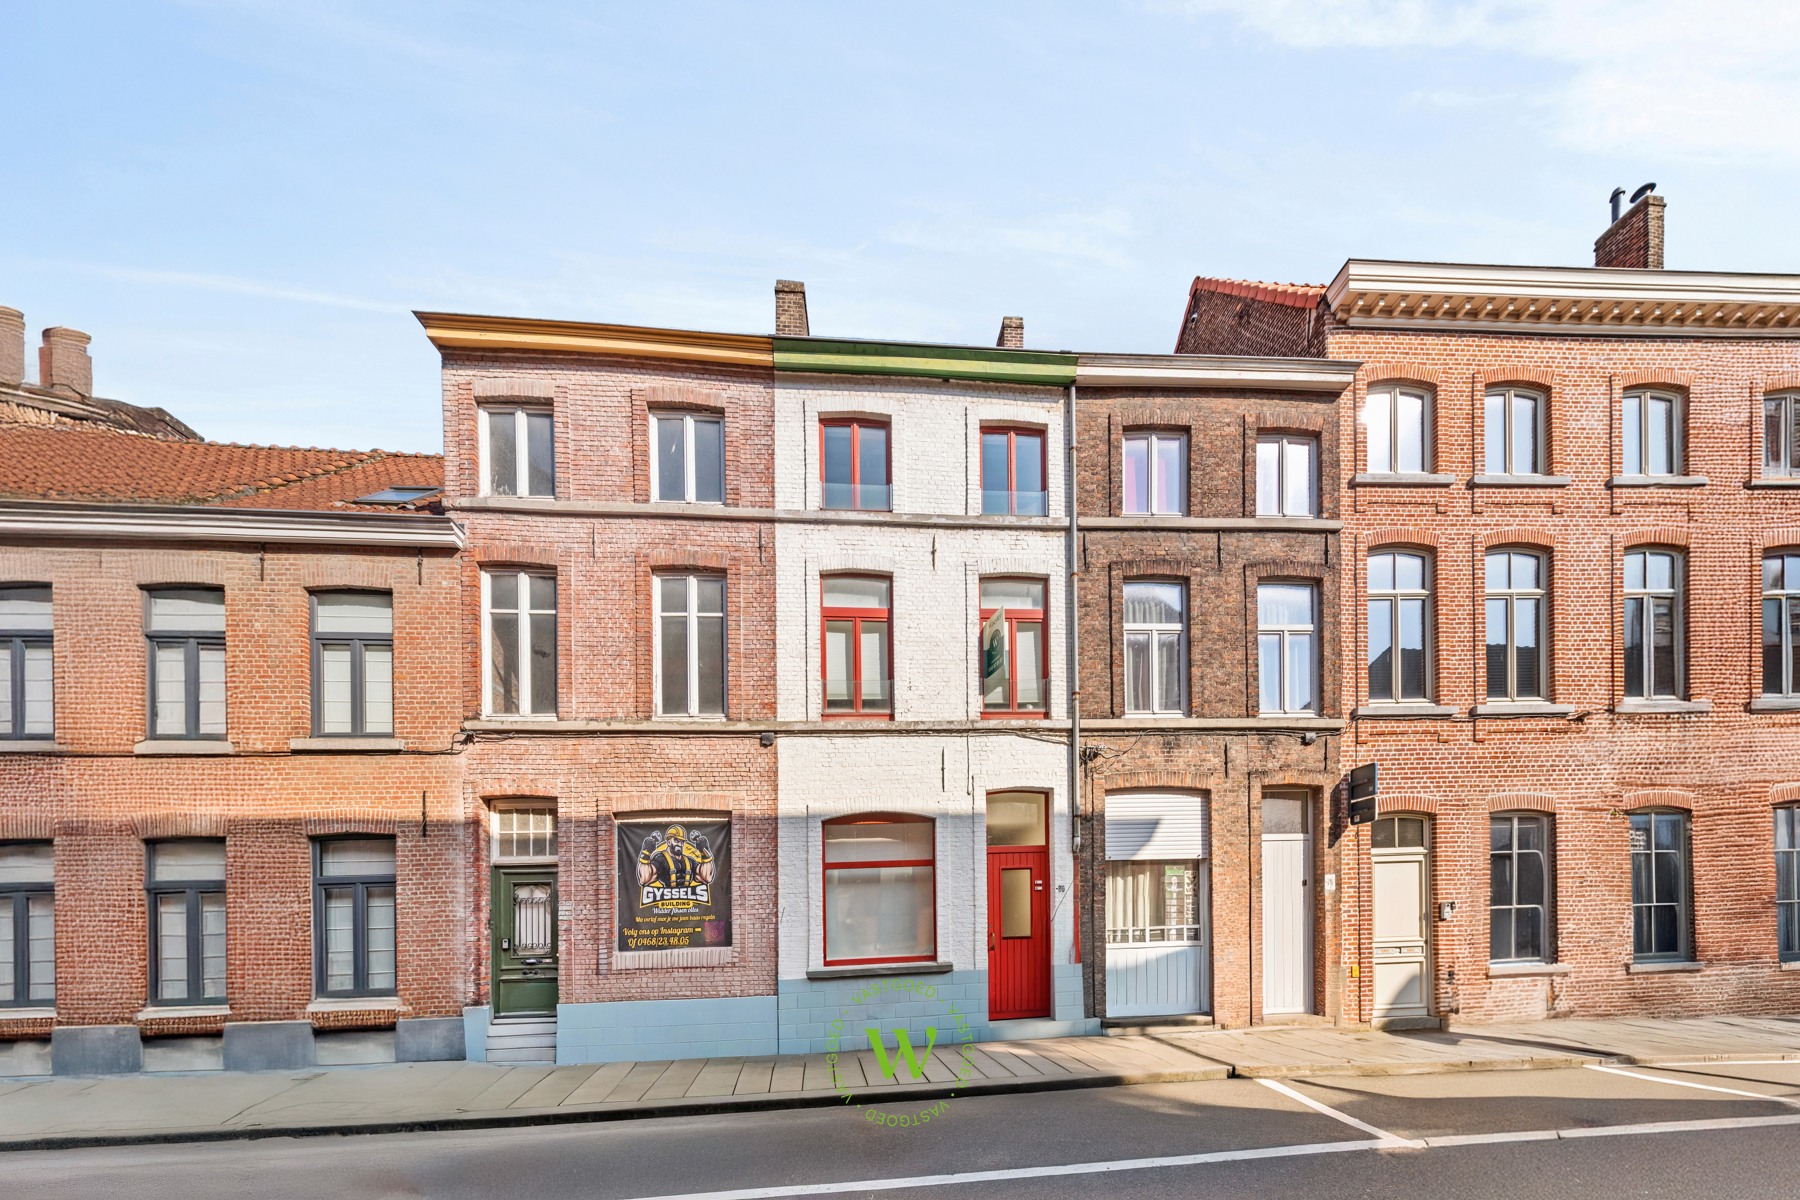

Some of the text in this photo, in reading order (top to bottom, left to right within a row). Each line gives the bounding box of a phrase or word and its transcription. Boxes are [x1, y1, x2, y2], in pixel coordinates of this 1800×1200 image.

[642, 884, 708, 904] GYSSELS
[622, 927, 638, 938] Volg
[651, 928, 659, 937] op
[660, 926, 694, 936] Instagram
